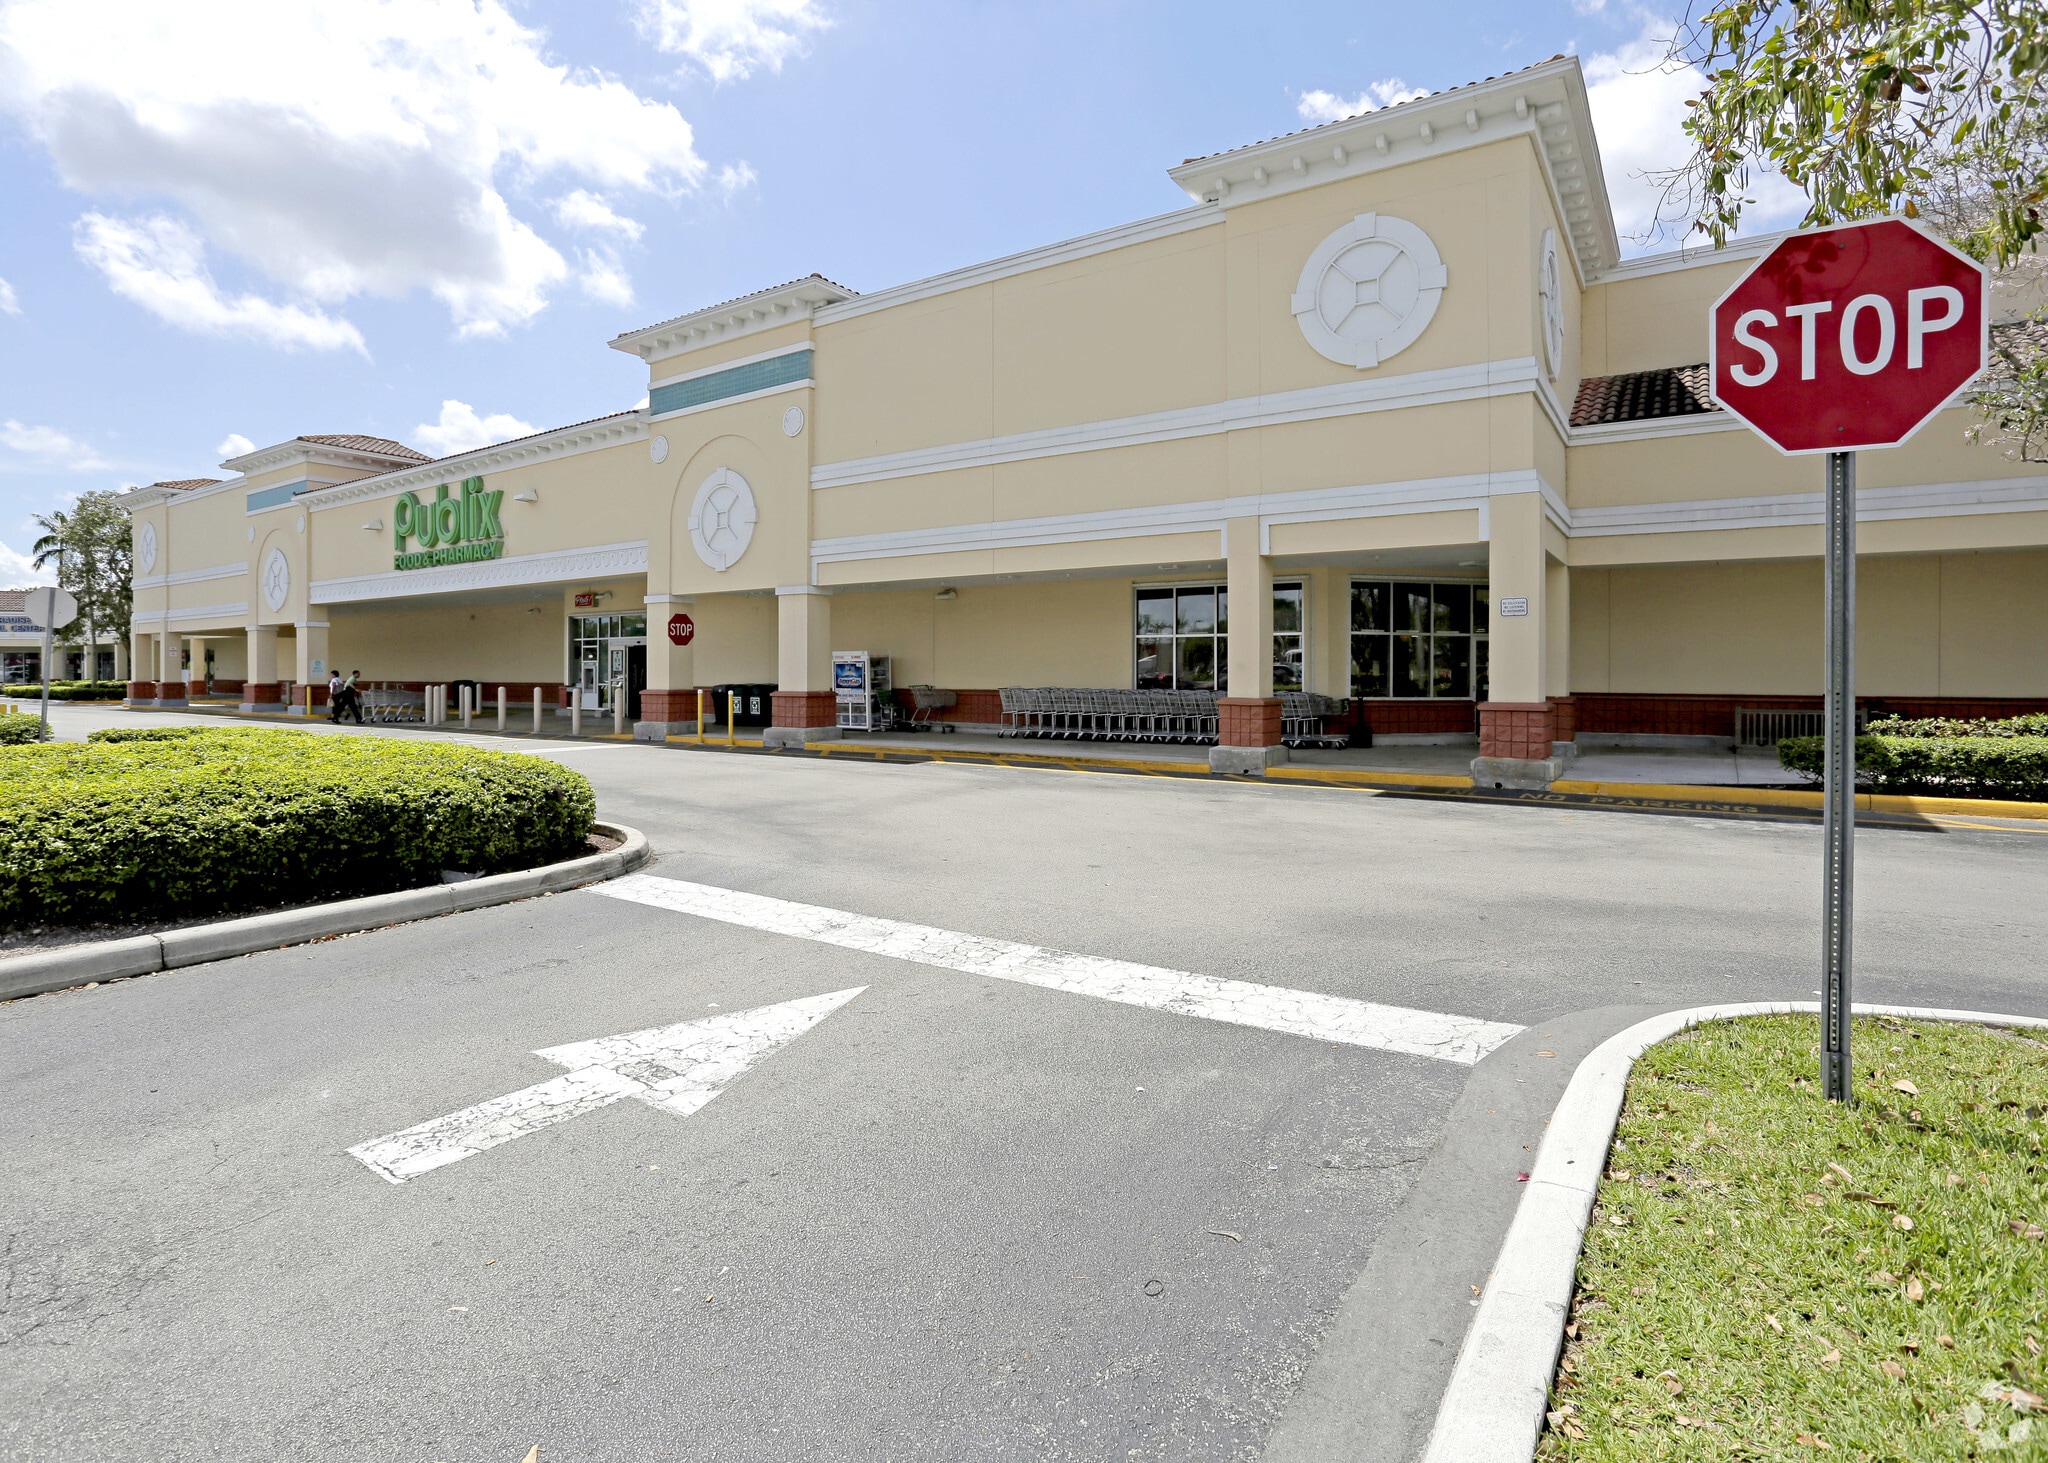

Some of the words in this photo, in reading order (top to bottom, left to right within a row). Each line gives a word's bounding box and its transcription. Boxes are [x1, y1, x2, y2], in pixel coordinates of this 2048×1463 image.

[1730, 285, 1964, 387] STOP
[394, 476, 504, 553] Publix
[394, 553, 421, 571] FOOD
[422, 551, 434, 568] &
[433, 541, 504, 564] PHARMACY
[669, 623, 693, 636] STOP
[1519, 792, 1566, 802] NO
[1589, 796, 1759, 813] PARKING
